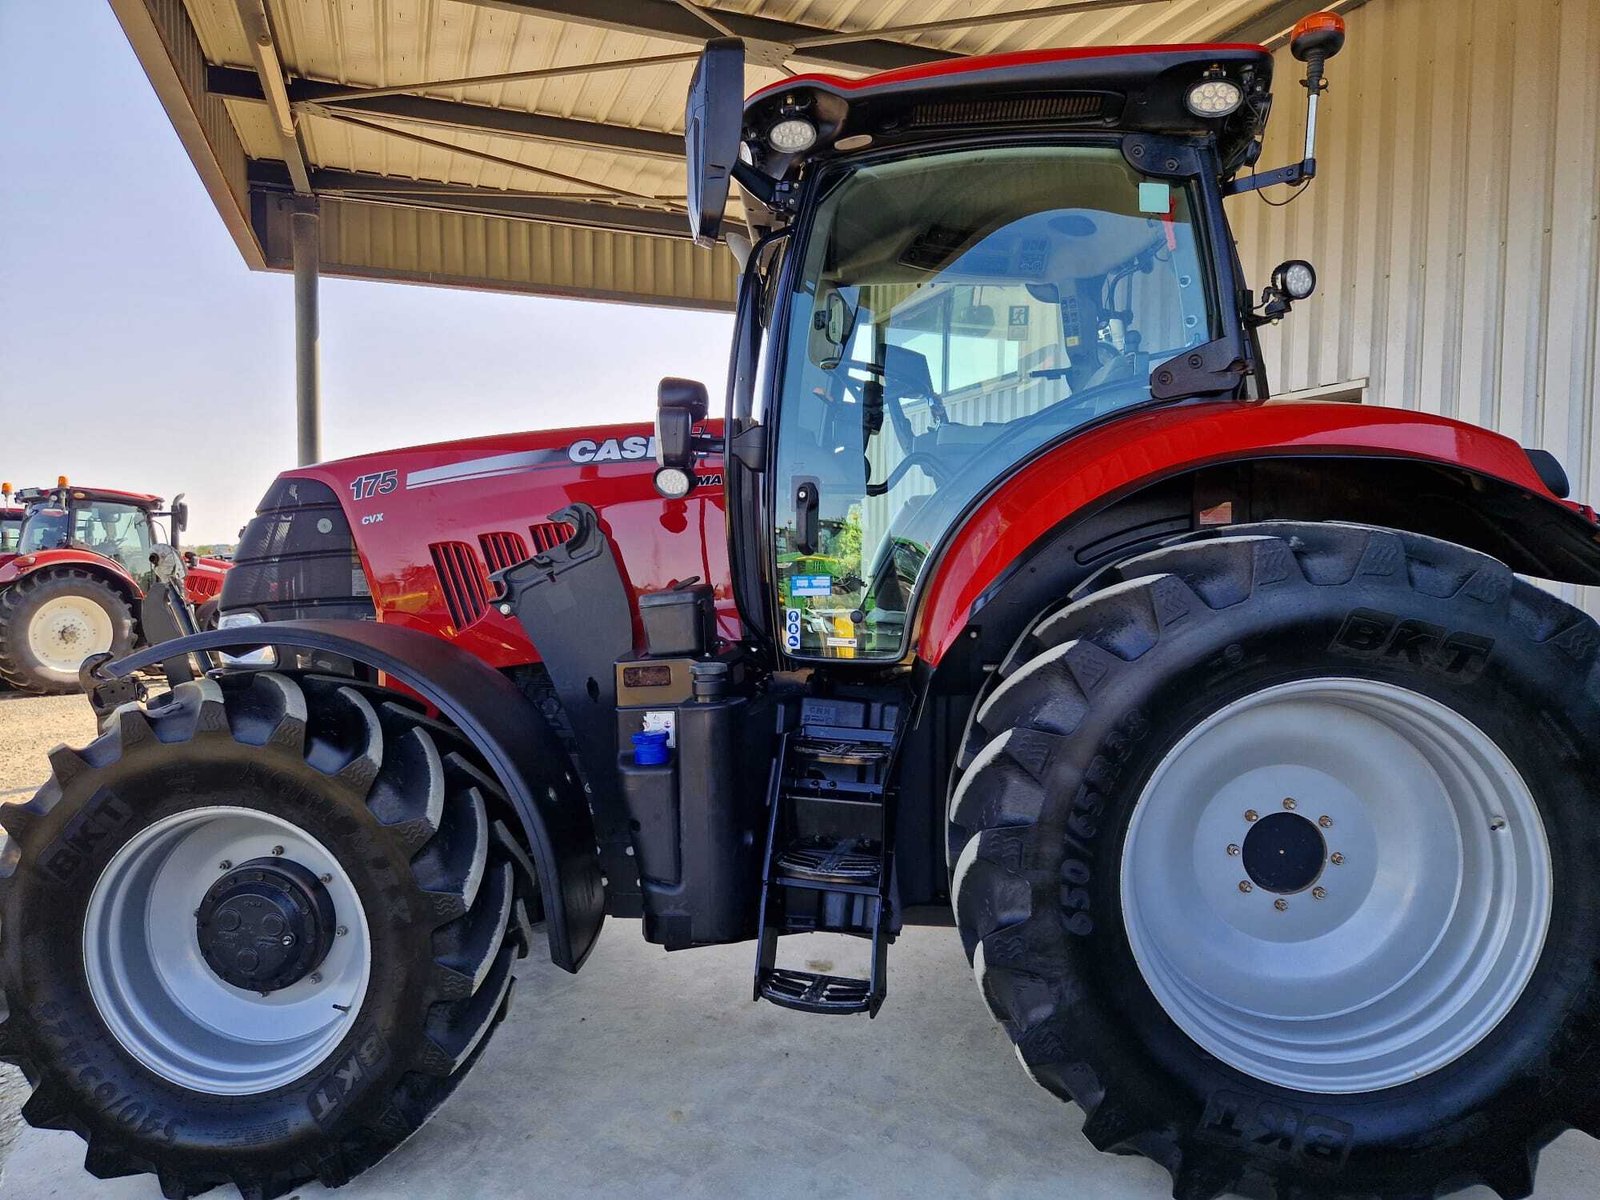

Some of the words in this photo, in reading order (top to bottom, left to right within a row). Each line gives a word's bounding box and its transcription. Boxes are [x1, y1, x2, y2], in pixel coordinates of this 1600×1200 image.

[568, 436, 656, 463] CAS
[350, 469, 398, 500] 175
[697, 474, 724, 486] MA
[362, 513, 384, 525] CVX
[1331, 611, 1491, 678] BKT
[45, 796, 128, 881] BKT
[314, 1032, 388, 1121] BKT
